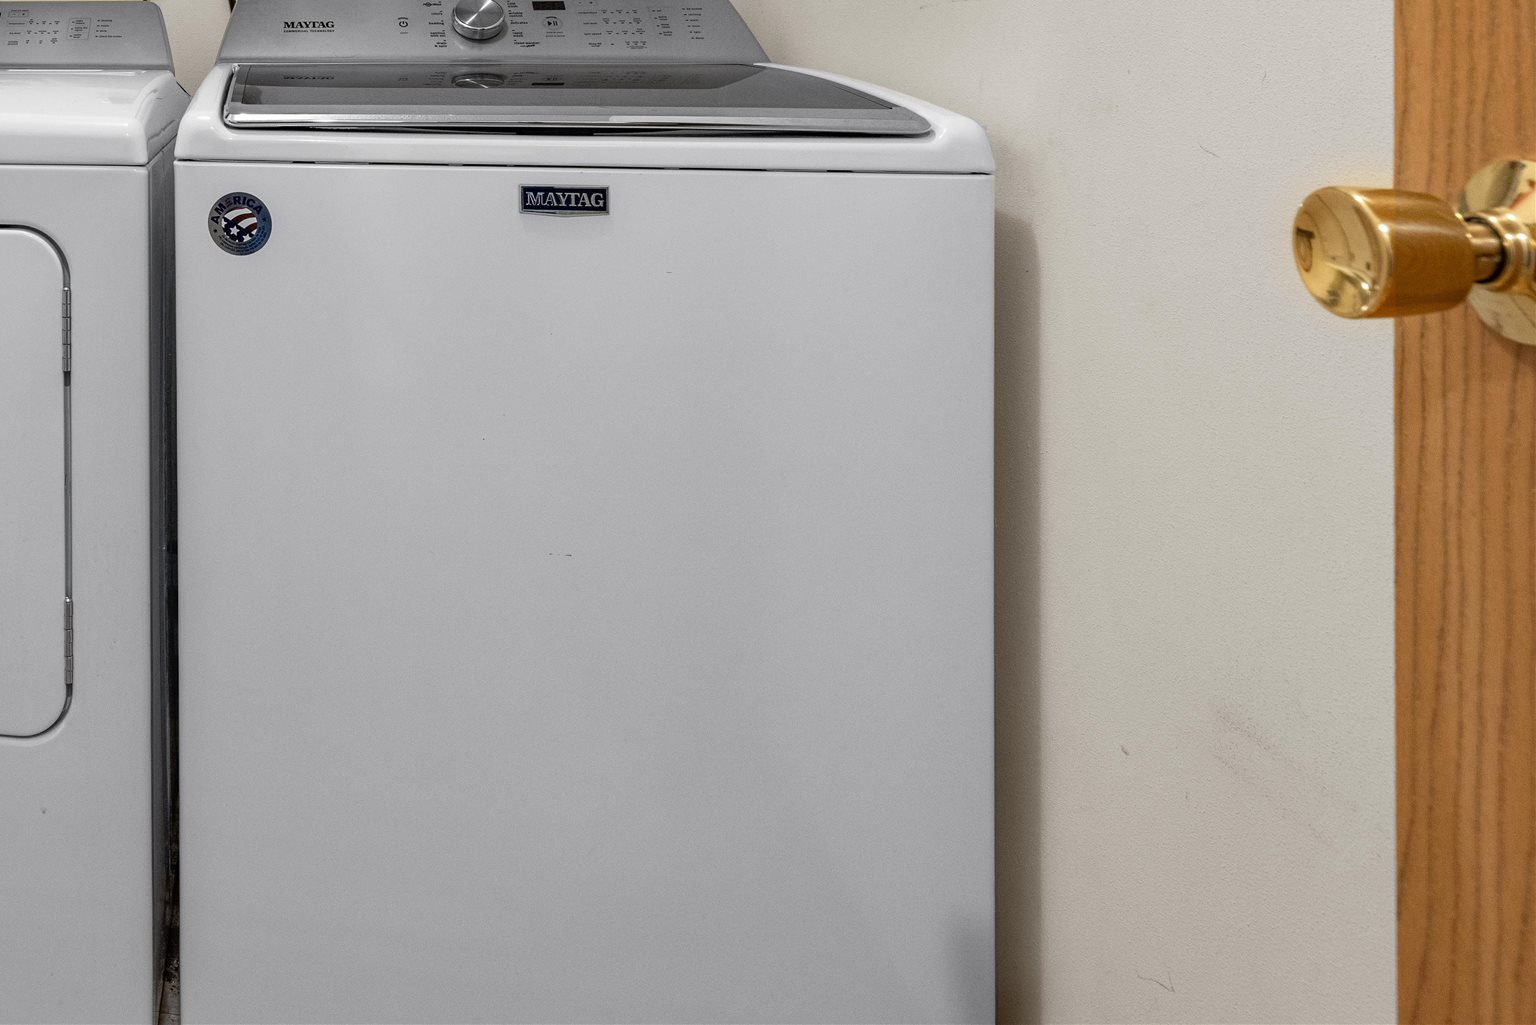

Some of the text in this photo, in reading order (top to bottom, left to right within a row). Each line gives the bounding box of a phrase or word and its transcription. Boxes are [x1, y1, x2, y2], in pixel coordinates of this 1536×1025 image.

[283, 20, 335, 29] MAYTAG
[525, 191, 605, 207] MAYTAG
[210, 195, 263, 225] AMERICA
